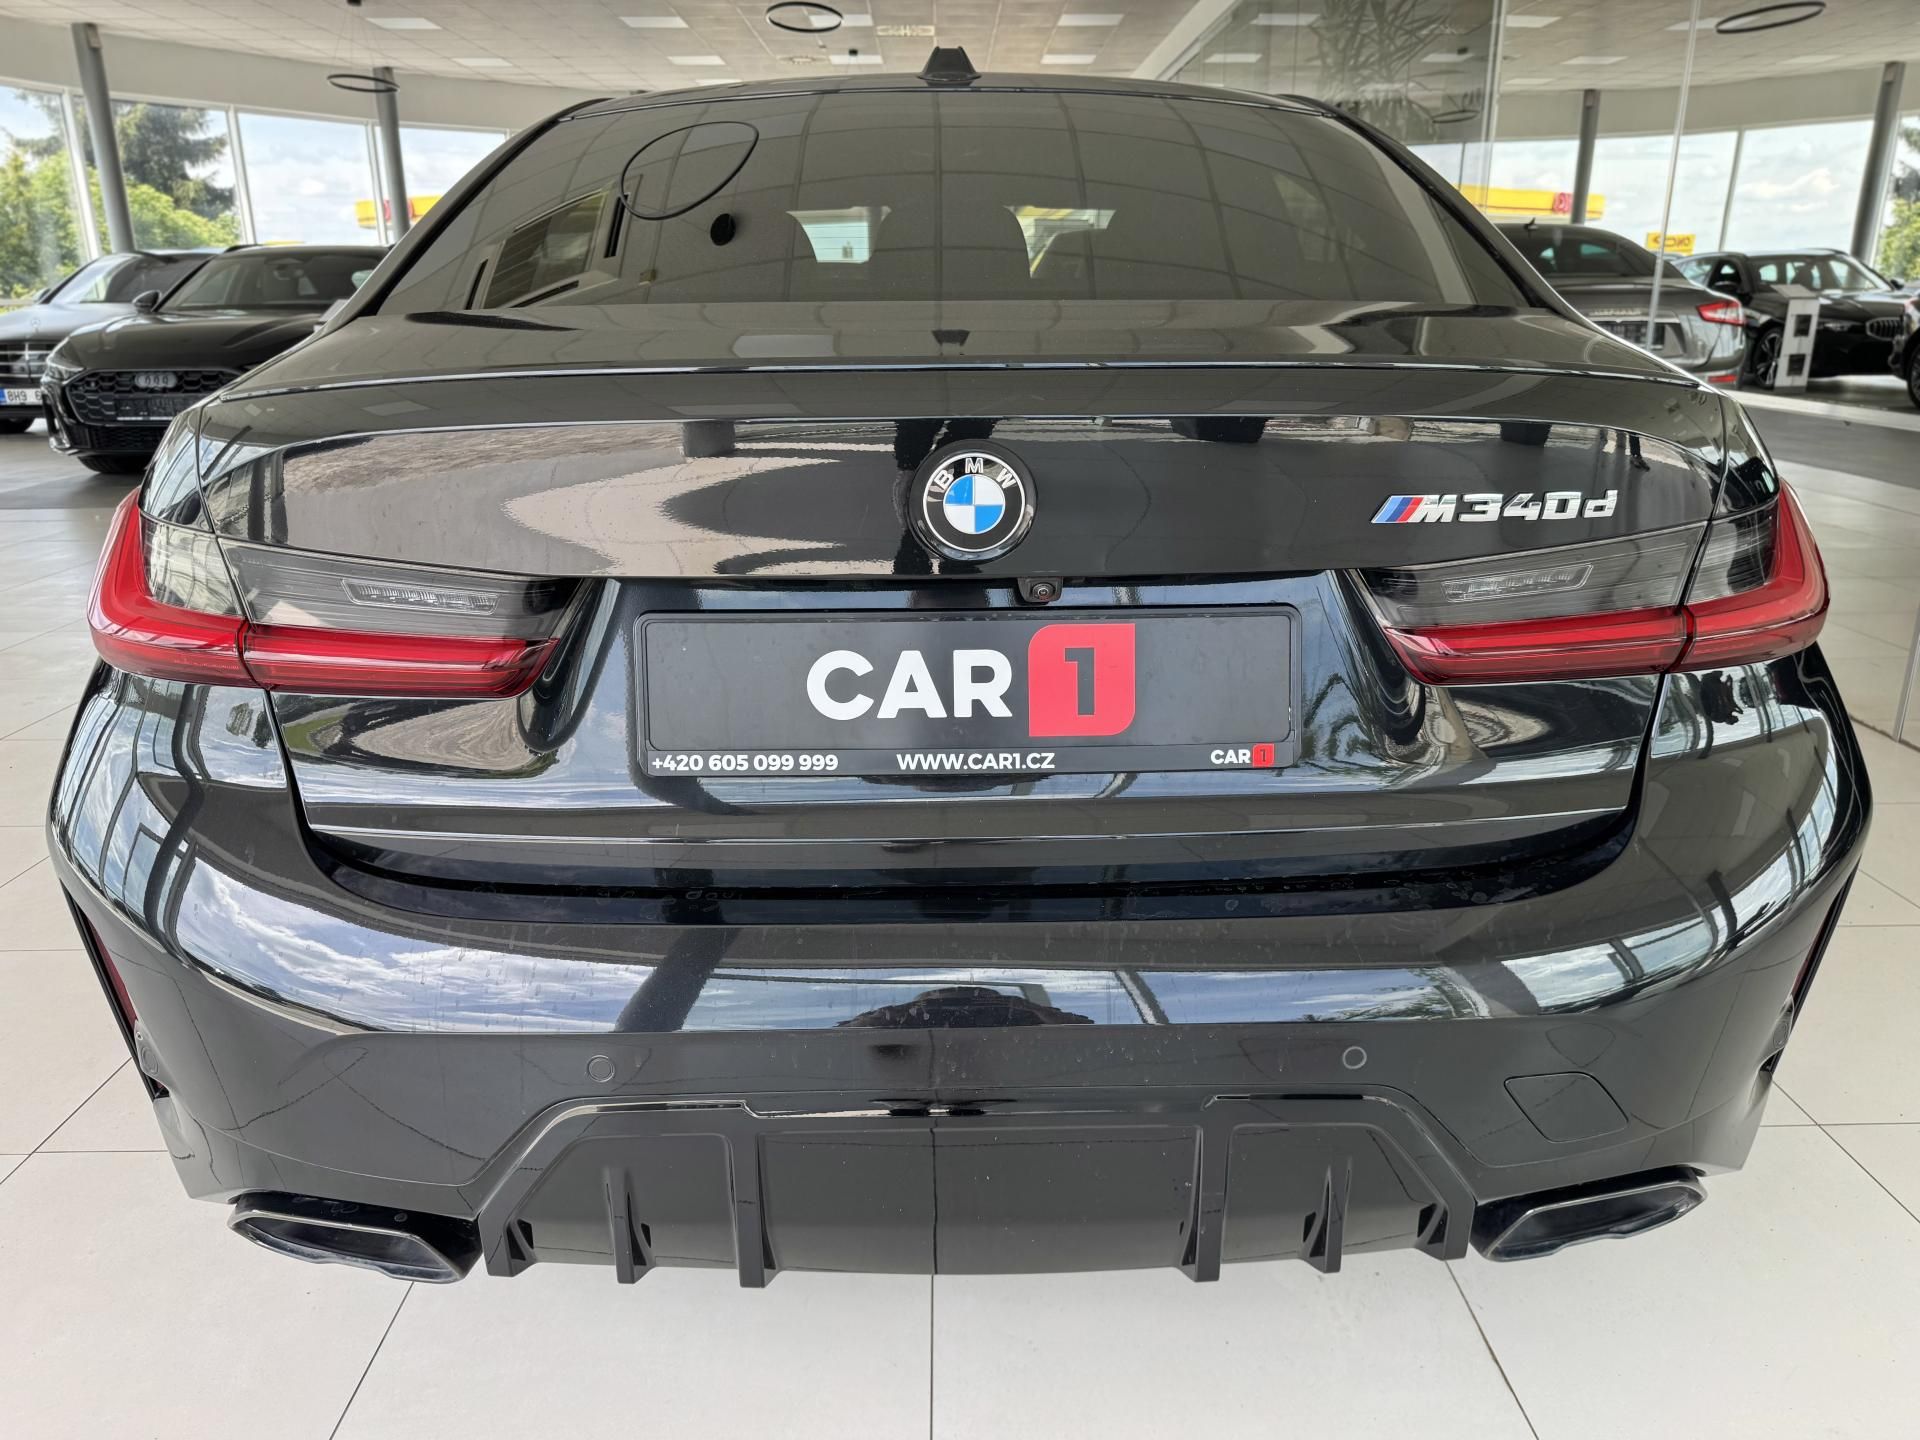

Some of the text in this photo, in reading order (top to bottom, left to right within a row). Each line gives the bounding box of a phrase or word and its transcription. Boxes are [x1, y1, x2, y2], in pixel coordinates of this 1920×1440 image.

[933, 457, 1017, 490] BMW
[1404, 489, 1619, 523] M340d
[806, 649, 1013, 721] CAR
[652, 754, 839, 771] +420 605 099 999
[896, 752, 1055, 770] WWW.CAR1.CZ
[1210, 749, 1251, 765] CAR
